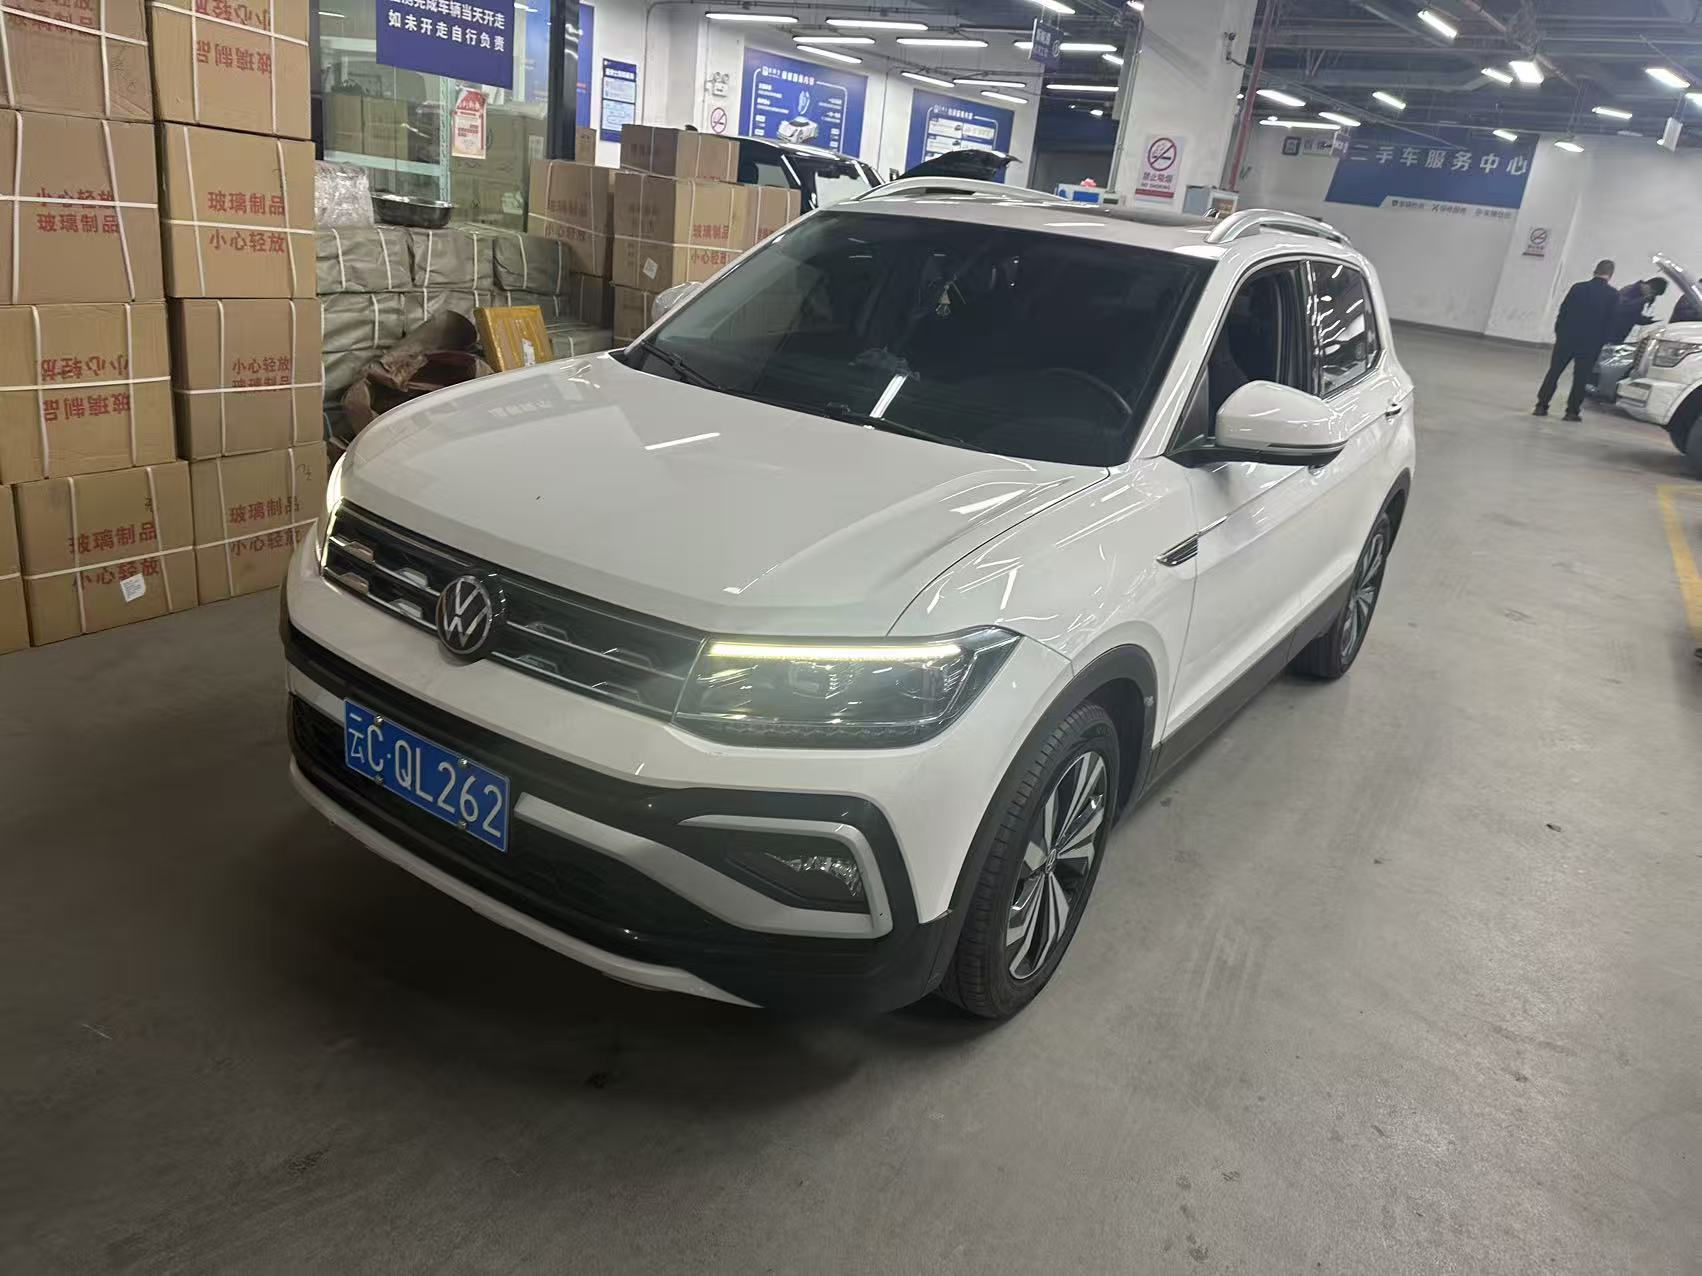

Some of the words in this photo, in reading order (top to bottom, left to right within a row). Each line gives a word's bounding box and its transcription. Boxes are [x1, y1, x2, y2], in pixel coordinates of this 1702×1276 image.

[391, 0, 505, 29] 完成车辆当天开走
[388, 9, 505, 51] 如未开走自行负责
[1350, 144, 1528, 176] 二手车服务中心
[208, 191, 285, 216] 玻璃制品
[36, 212, 119, 233] 玻璃制品
[209, 232, 285, 253] 小心轻放
[41, 355, 129, 382] 小心轻放
[232, 356, 289, 374] 小心轻放
[43, 391, 130, 422] 玻璃制品
[229, 496, 300, 525] 玻璃制品
[68, 522, 157, 554] 玻璃制品
